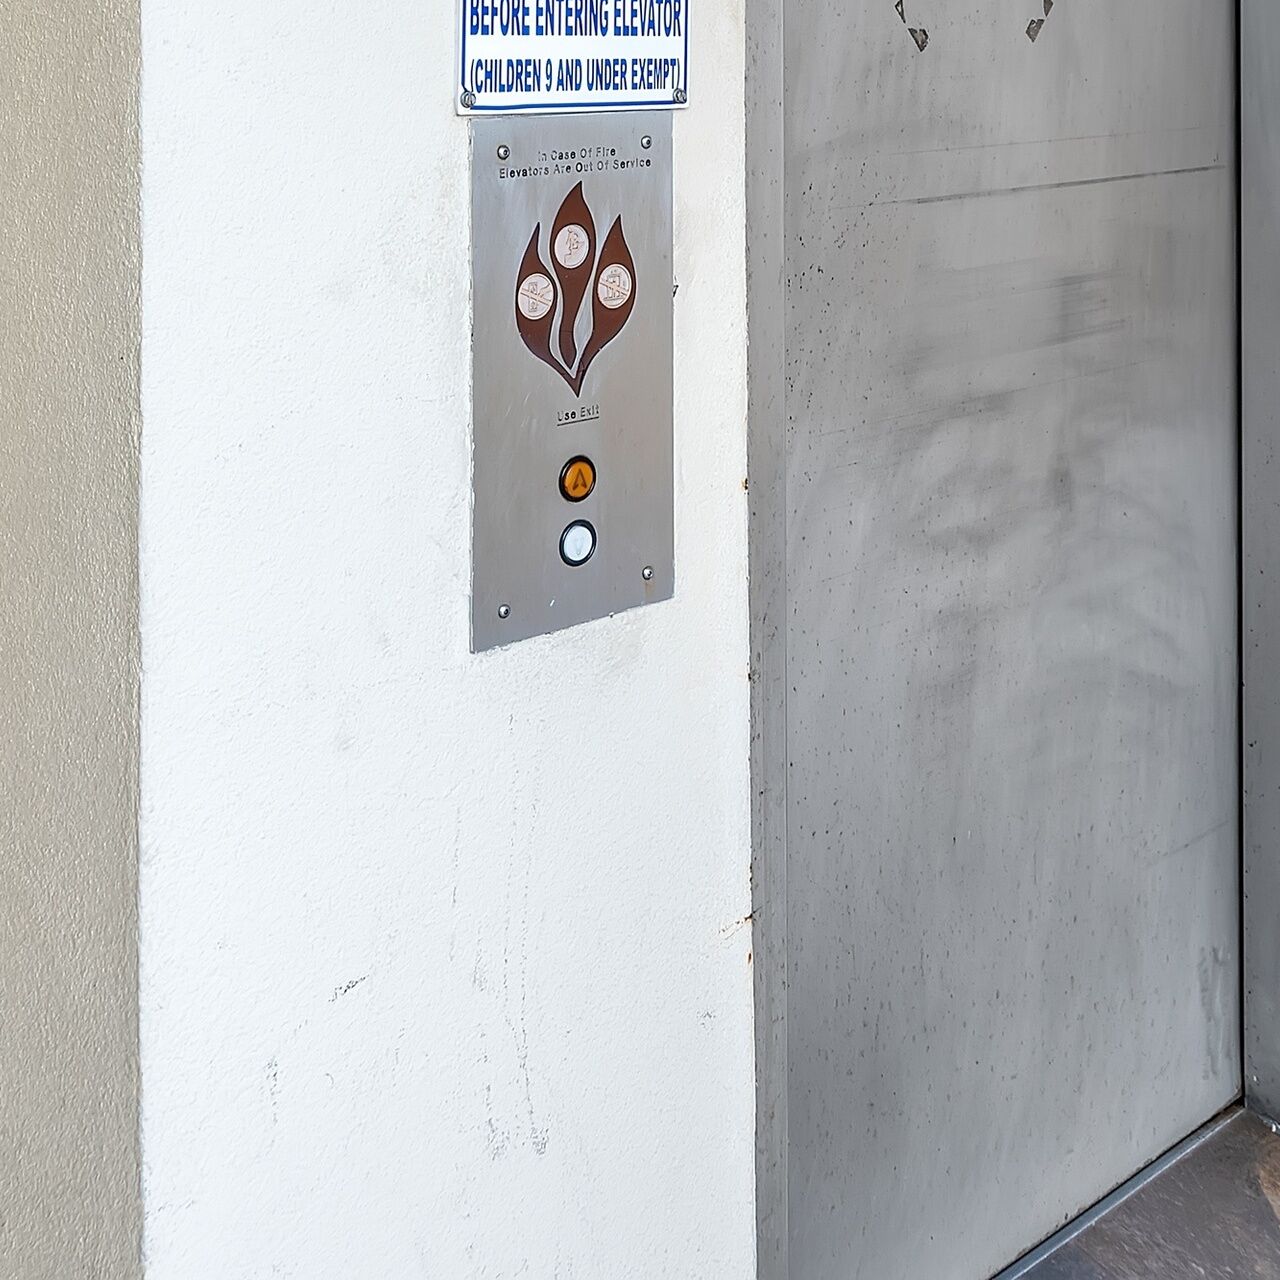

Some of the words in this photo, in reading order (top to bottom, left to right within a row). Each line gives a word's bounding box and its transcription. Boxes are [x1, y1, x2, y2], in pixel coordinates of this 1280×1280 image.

[470, 58, 541, 93] (CHILDREN
[545, 58, 553, 92] 9
[556, 58, 582, 91] AND
[587, 58, 627, 91] UNDER
[631, 58, 681, 90] EXEMPT)
[537, 150, 547, 162] In
[551, 149, 576, 161] Case
[580, 147, 592, 159] Of
[596, 146, 616, 157] Fire
[499, 165, 549, 179] Elevators
[553, 163, 571, 174] Are
[575, 161, 593, 173] Out
[597, 160, 609, 170] Of
[612, 156, 651, 169] Service
[557, 410, 576, 421] Use
[581, 404, 599, 417] Exit
